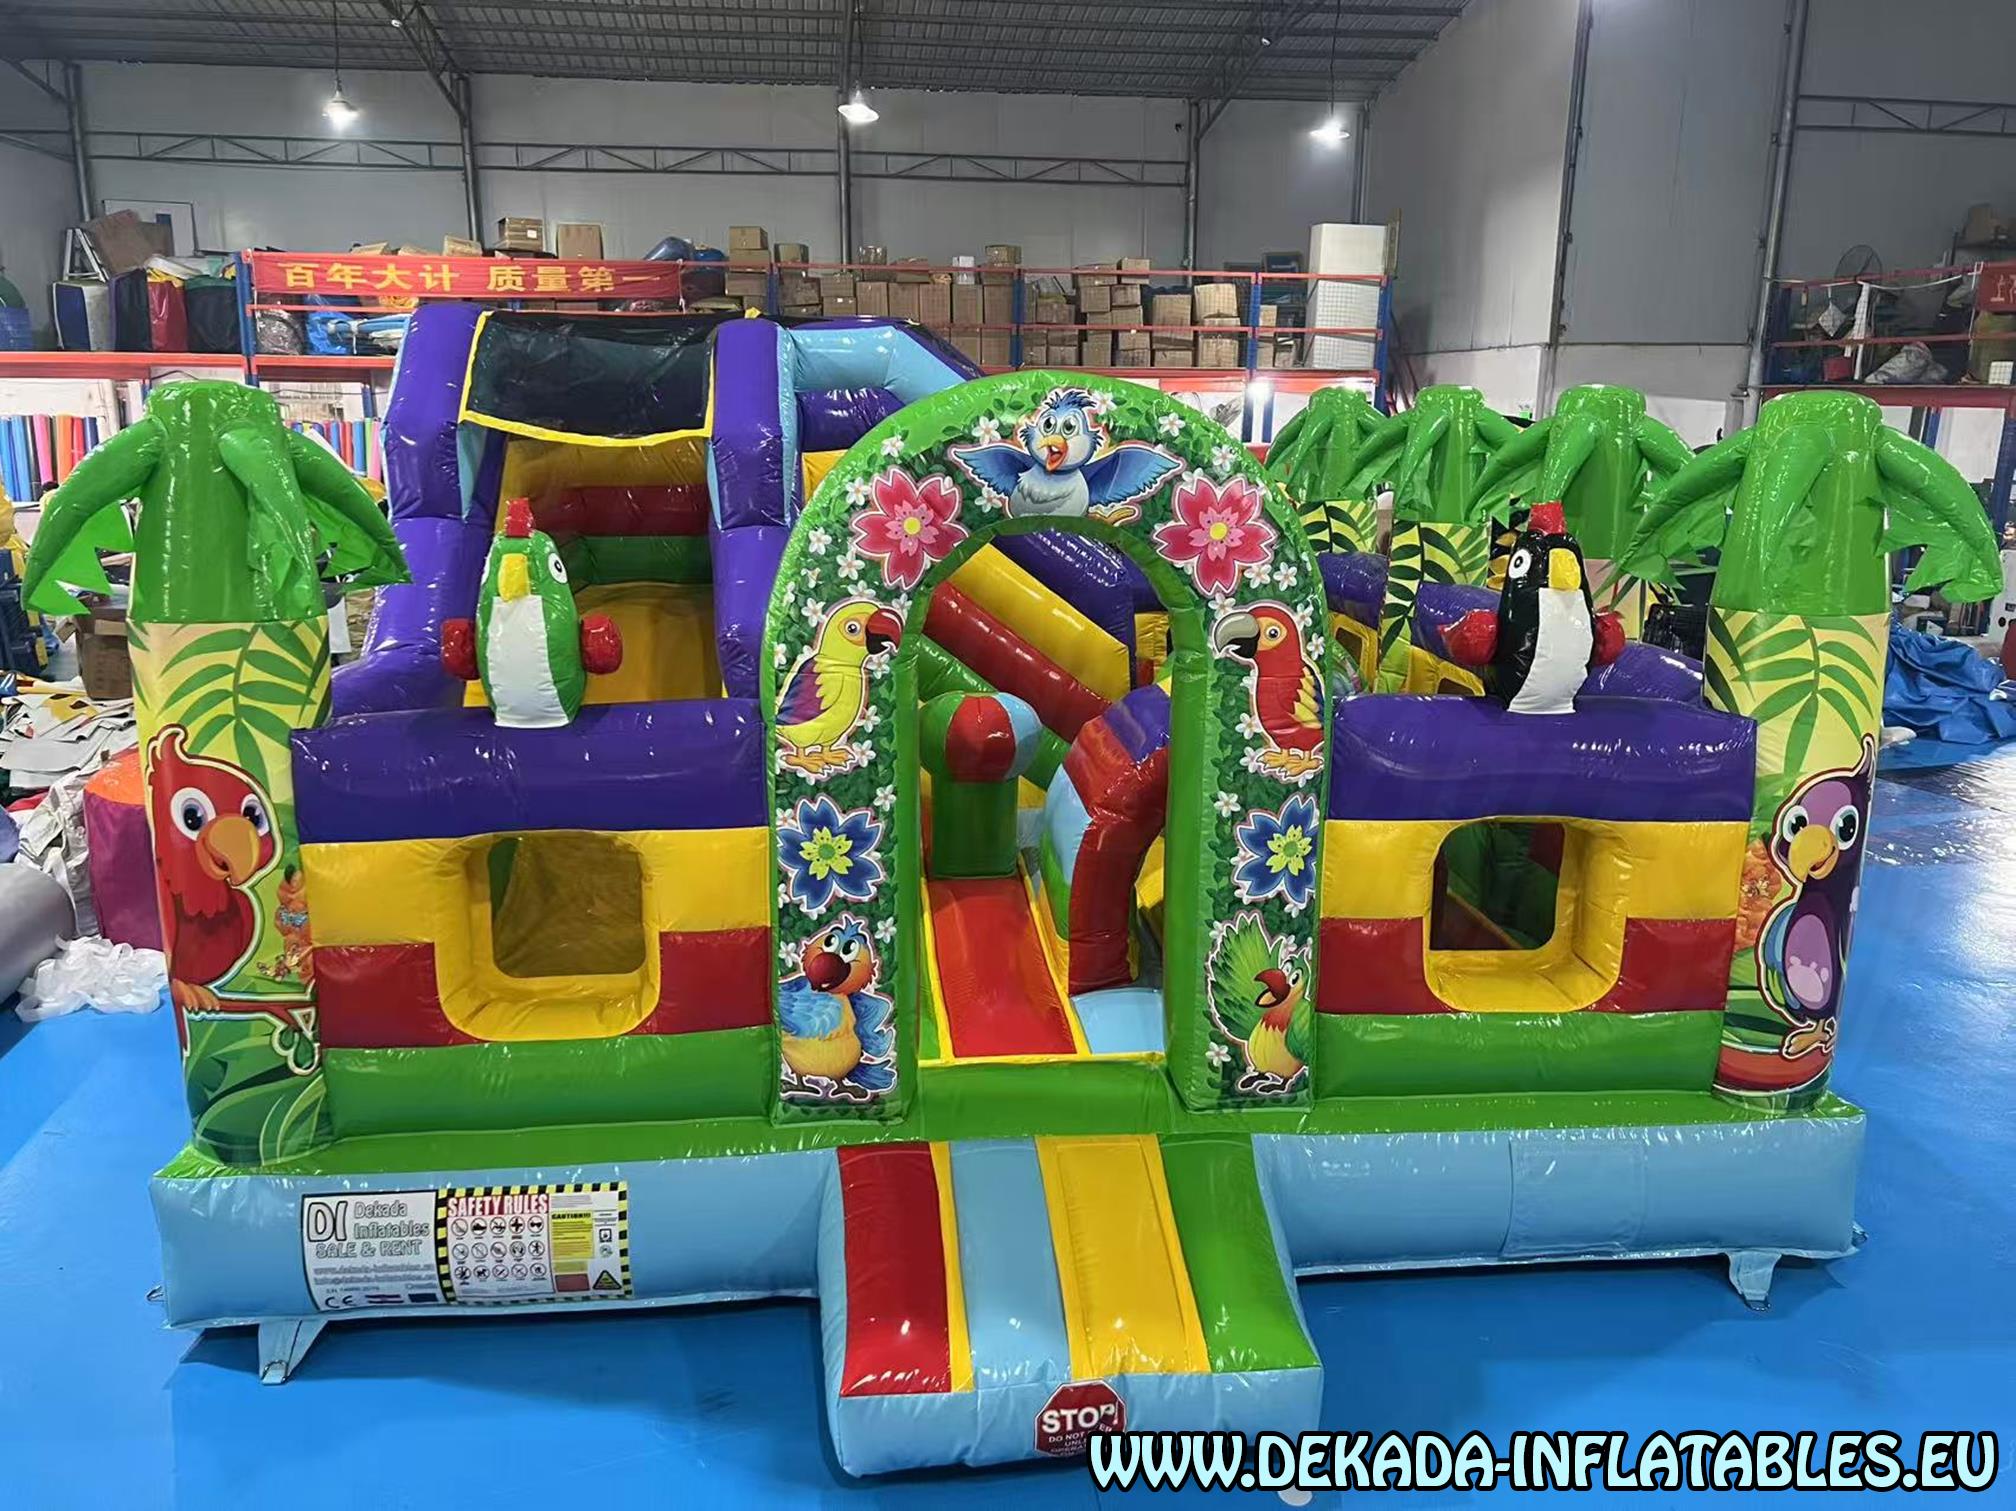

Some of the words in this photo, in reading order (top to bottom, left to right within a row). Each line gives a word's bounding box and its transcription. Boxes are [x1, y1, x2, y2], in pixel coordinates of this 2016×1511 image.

[278, 262, 460, 292] 百年大计
[487, 265, 661, 292] 质量第一
[354, 1200, 408, 1219] Dekada
[448, 1195, 501, 1217] SAFETY
[504, 1193, 549, 1215] RULES
[307, 1201, 348, 1242] DI
[353, 1221, 430, 1239] Inflatables
[316, 1242, 357, 1258] SALE
[360, 1242, 377, 1258] &
[380, 1240, 422, 1257] RENT
[1041, 1403, 1115, 1433] STOP
[1048, 1435, 1063, 1443] DO
[1065, 1431, 1085, 1440] NOT
